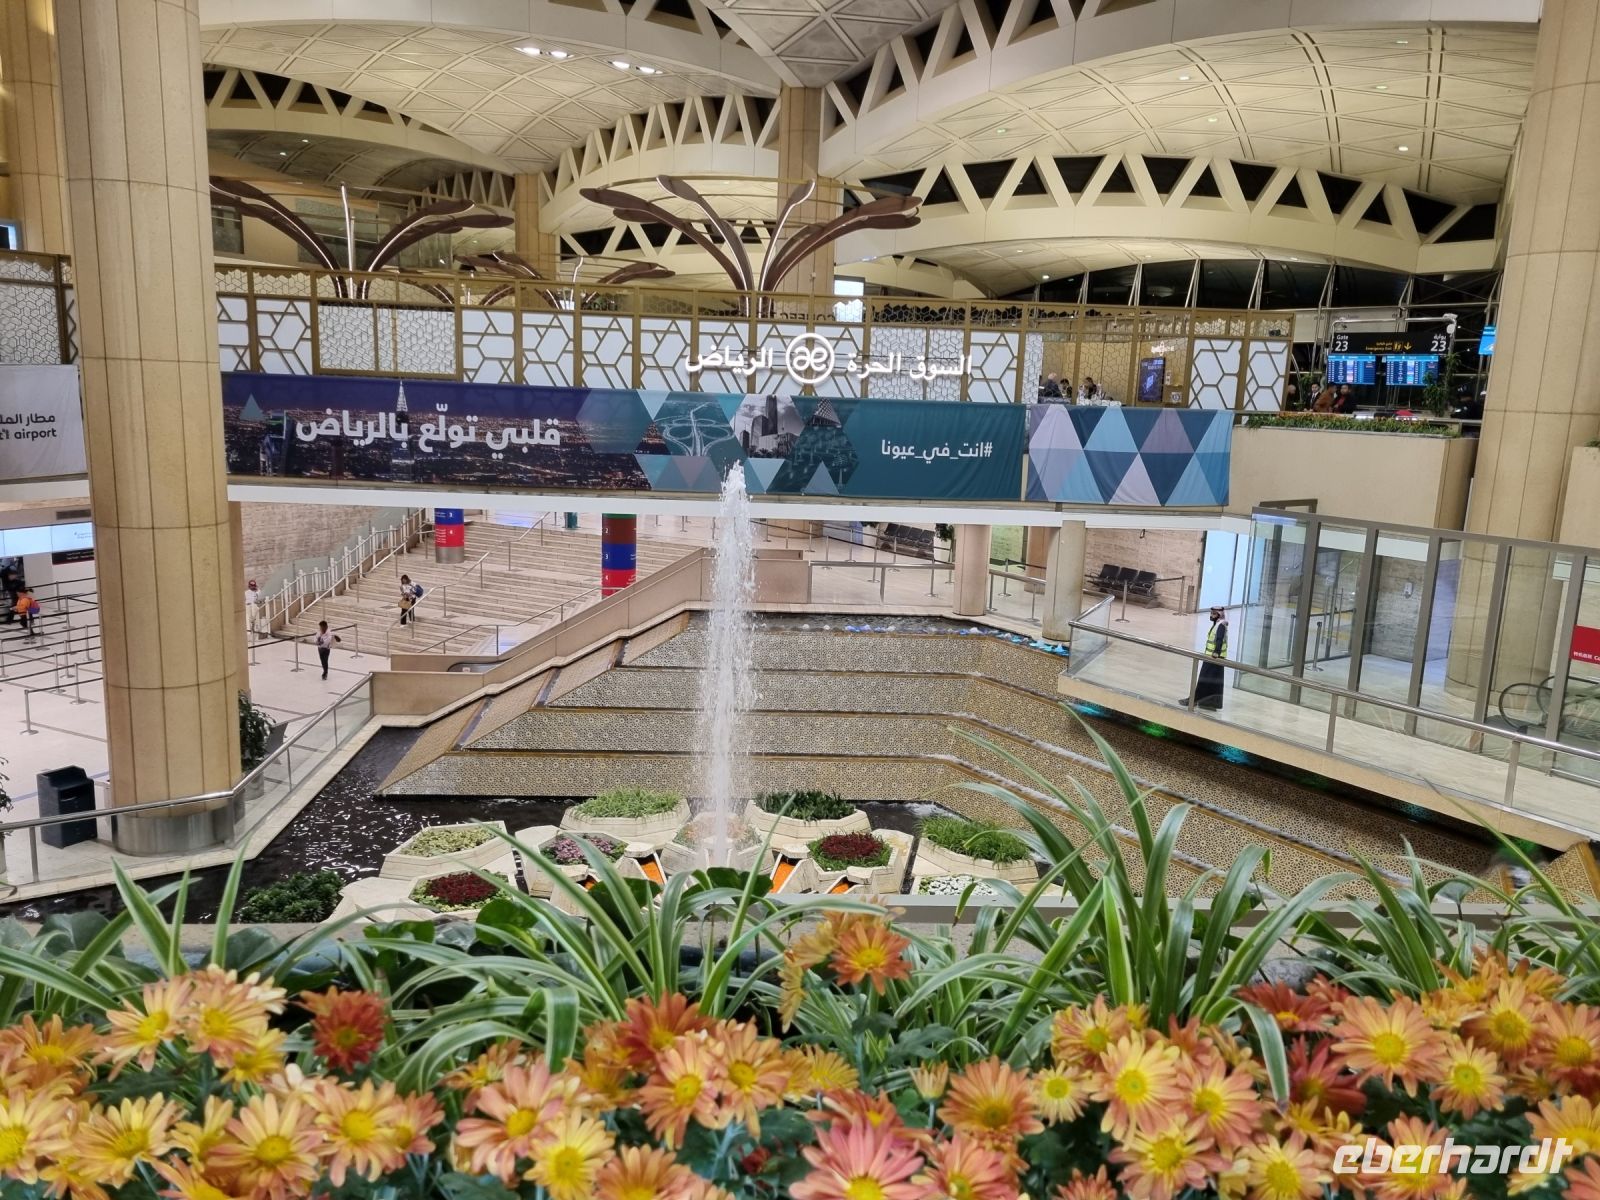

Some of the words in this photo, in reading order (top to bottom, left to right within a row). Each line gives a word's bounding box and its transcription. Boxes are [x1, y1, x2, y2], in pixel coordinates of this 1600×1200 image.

[1334, 341, 1349, 352] 23
[1430, 340, 1447, 352] 23
[685, 345, 774, 376] الرياض
[846, 350, 902, 379] الحرة
[909, 352, 973, 380] السوق
[26, 412, 56, 427] مطار
[296, 408, 411, 449] بالرياض
[14, 427, 57, 442] airport
[485, 418, 561, 460] قلبي
